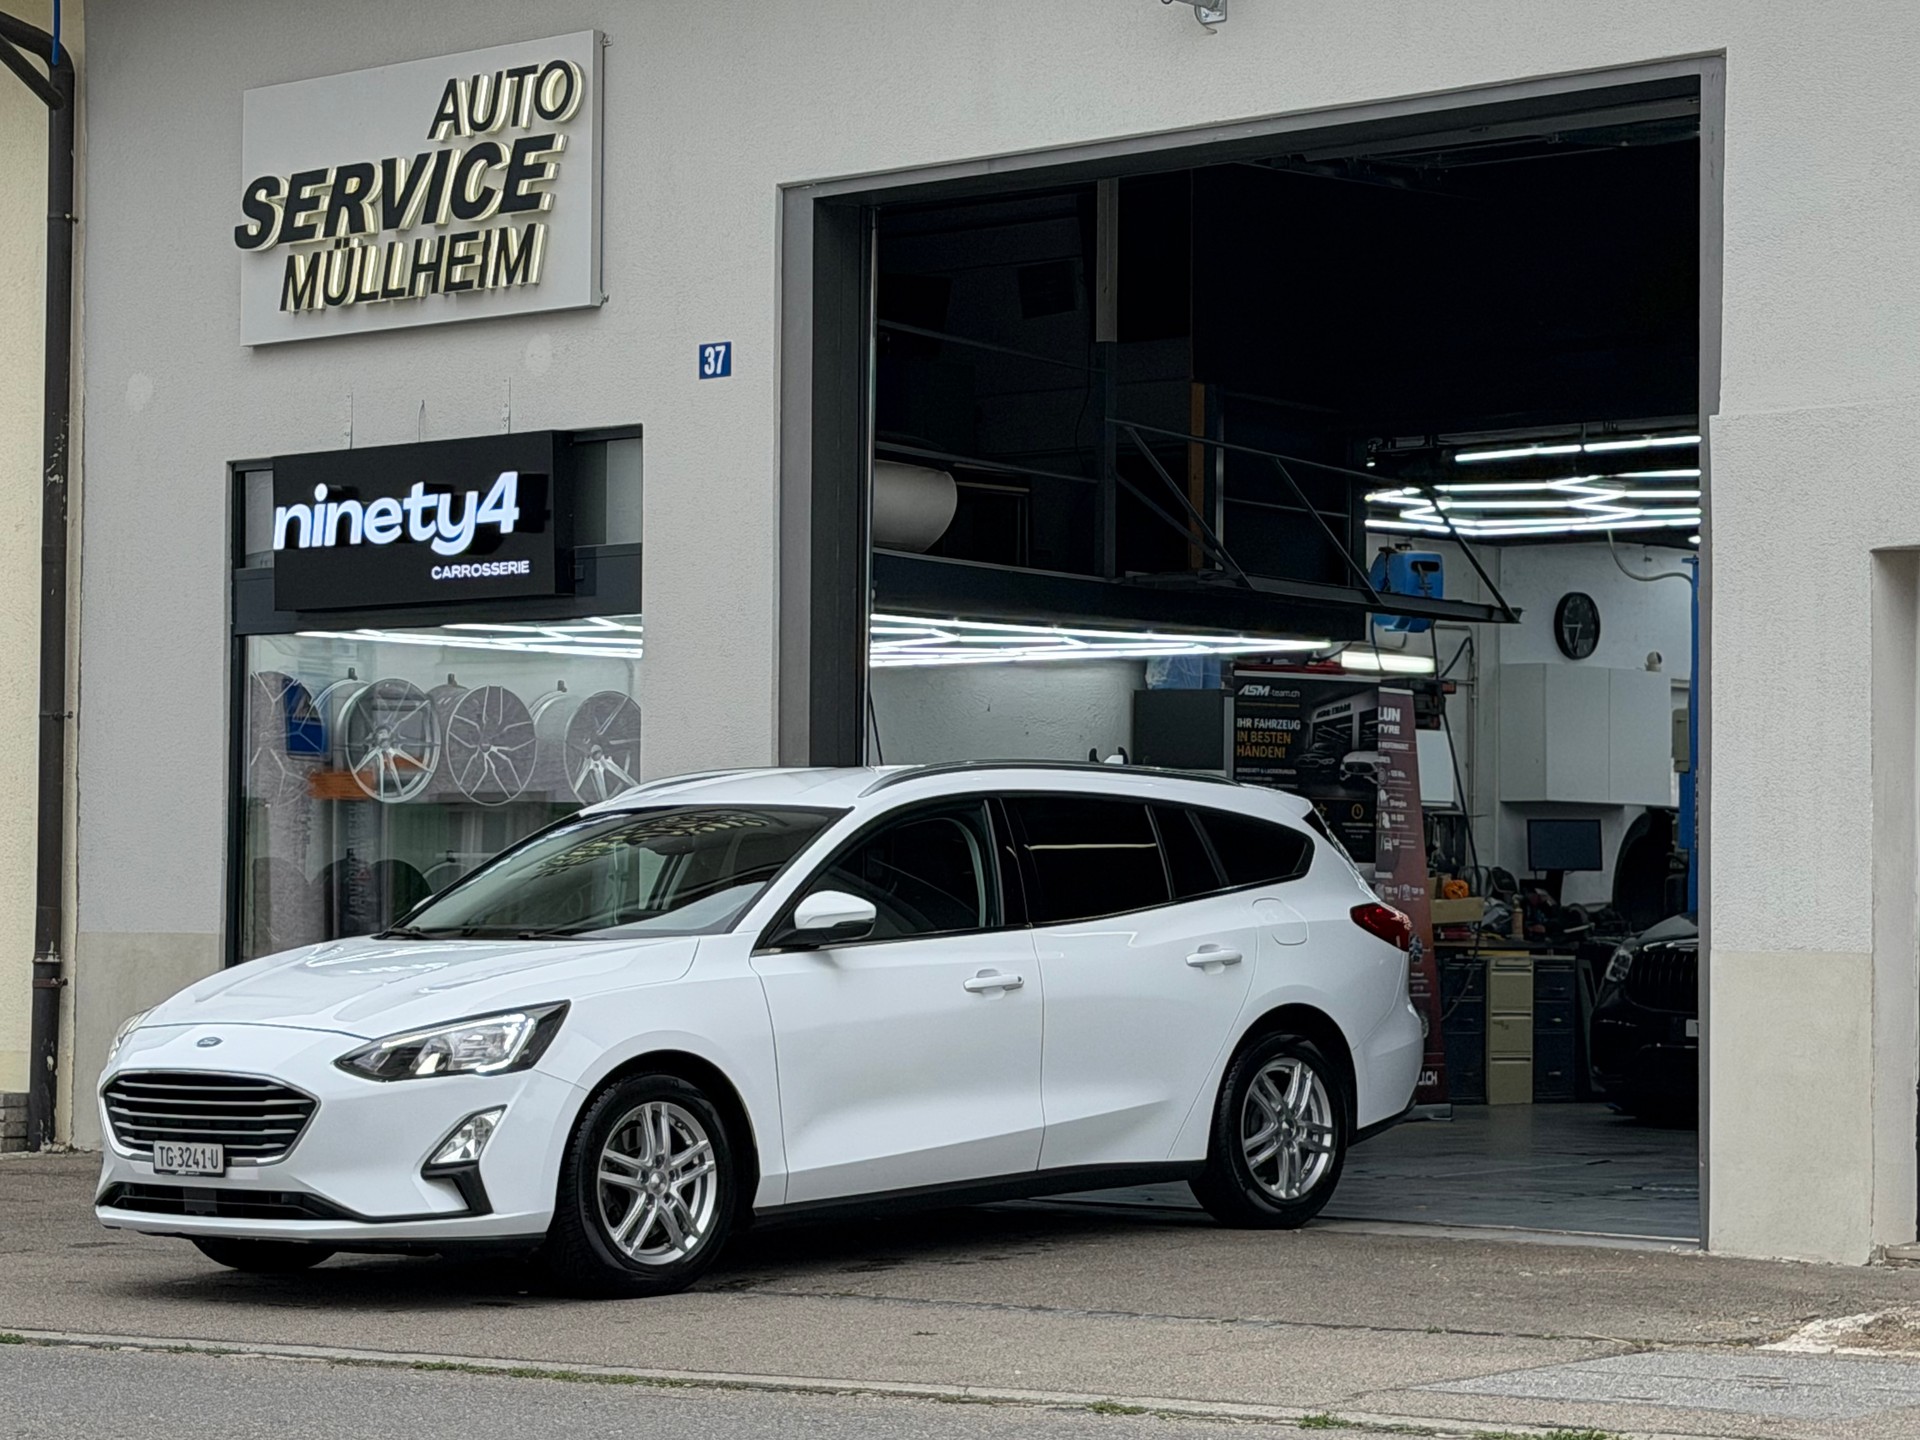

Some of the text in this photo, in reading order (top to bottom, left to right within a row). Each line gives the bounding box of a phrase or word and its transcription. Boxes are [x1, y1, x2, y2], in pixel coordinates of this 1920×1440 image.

[427, 59, 581, 140] AUTO
[234, 133, 566, 250] SERVICE
[280, 223, 545, 312] MÜLLHEIM
[703, 345, 726, 375] 37
[272, 471, 519, 556] ninety4
[431, 560, 530, 580] CARROSSERIE
[1236, 717, 1301, 731] IHR FAHRZEUG
[1237, 730, 1292, 744] IN BESTEN
[1236, 742, 1286, 759] HÄNDEN!
